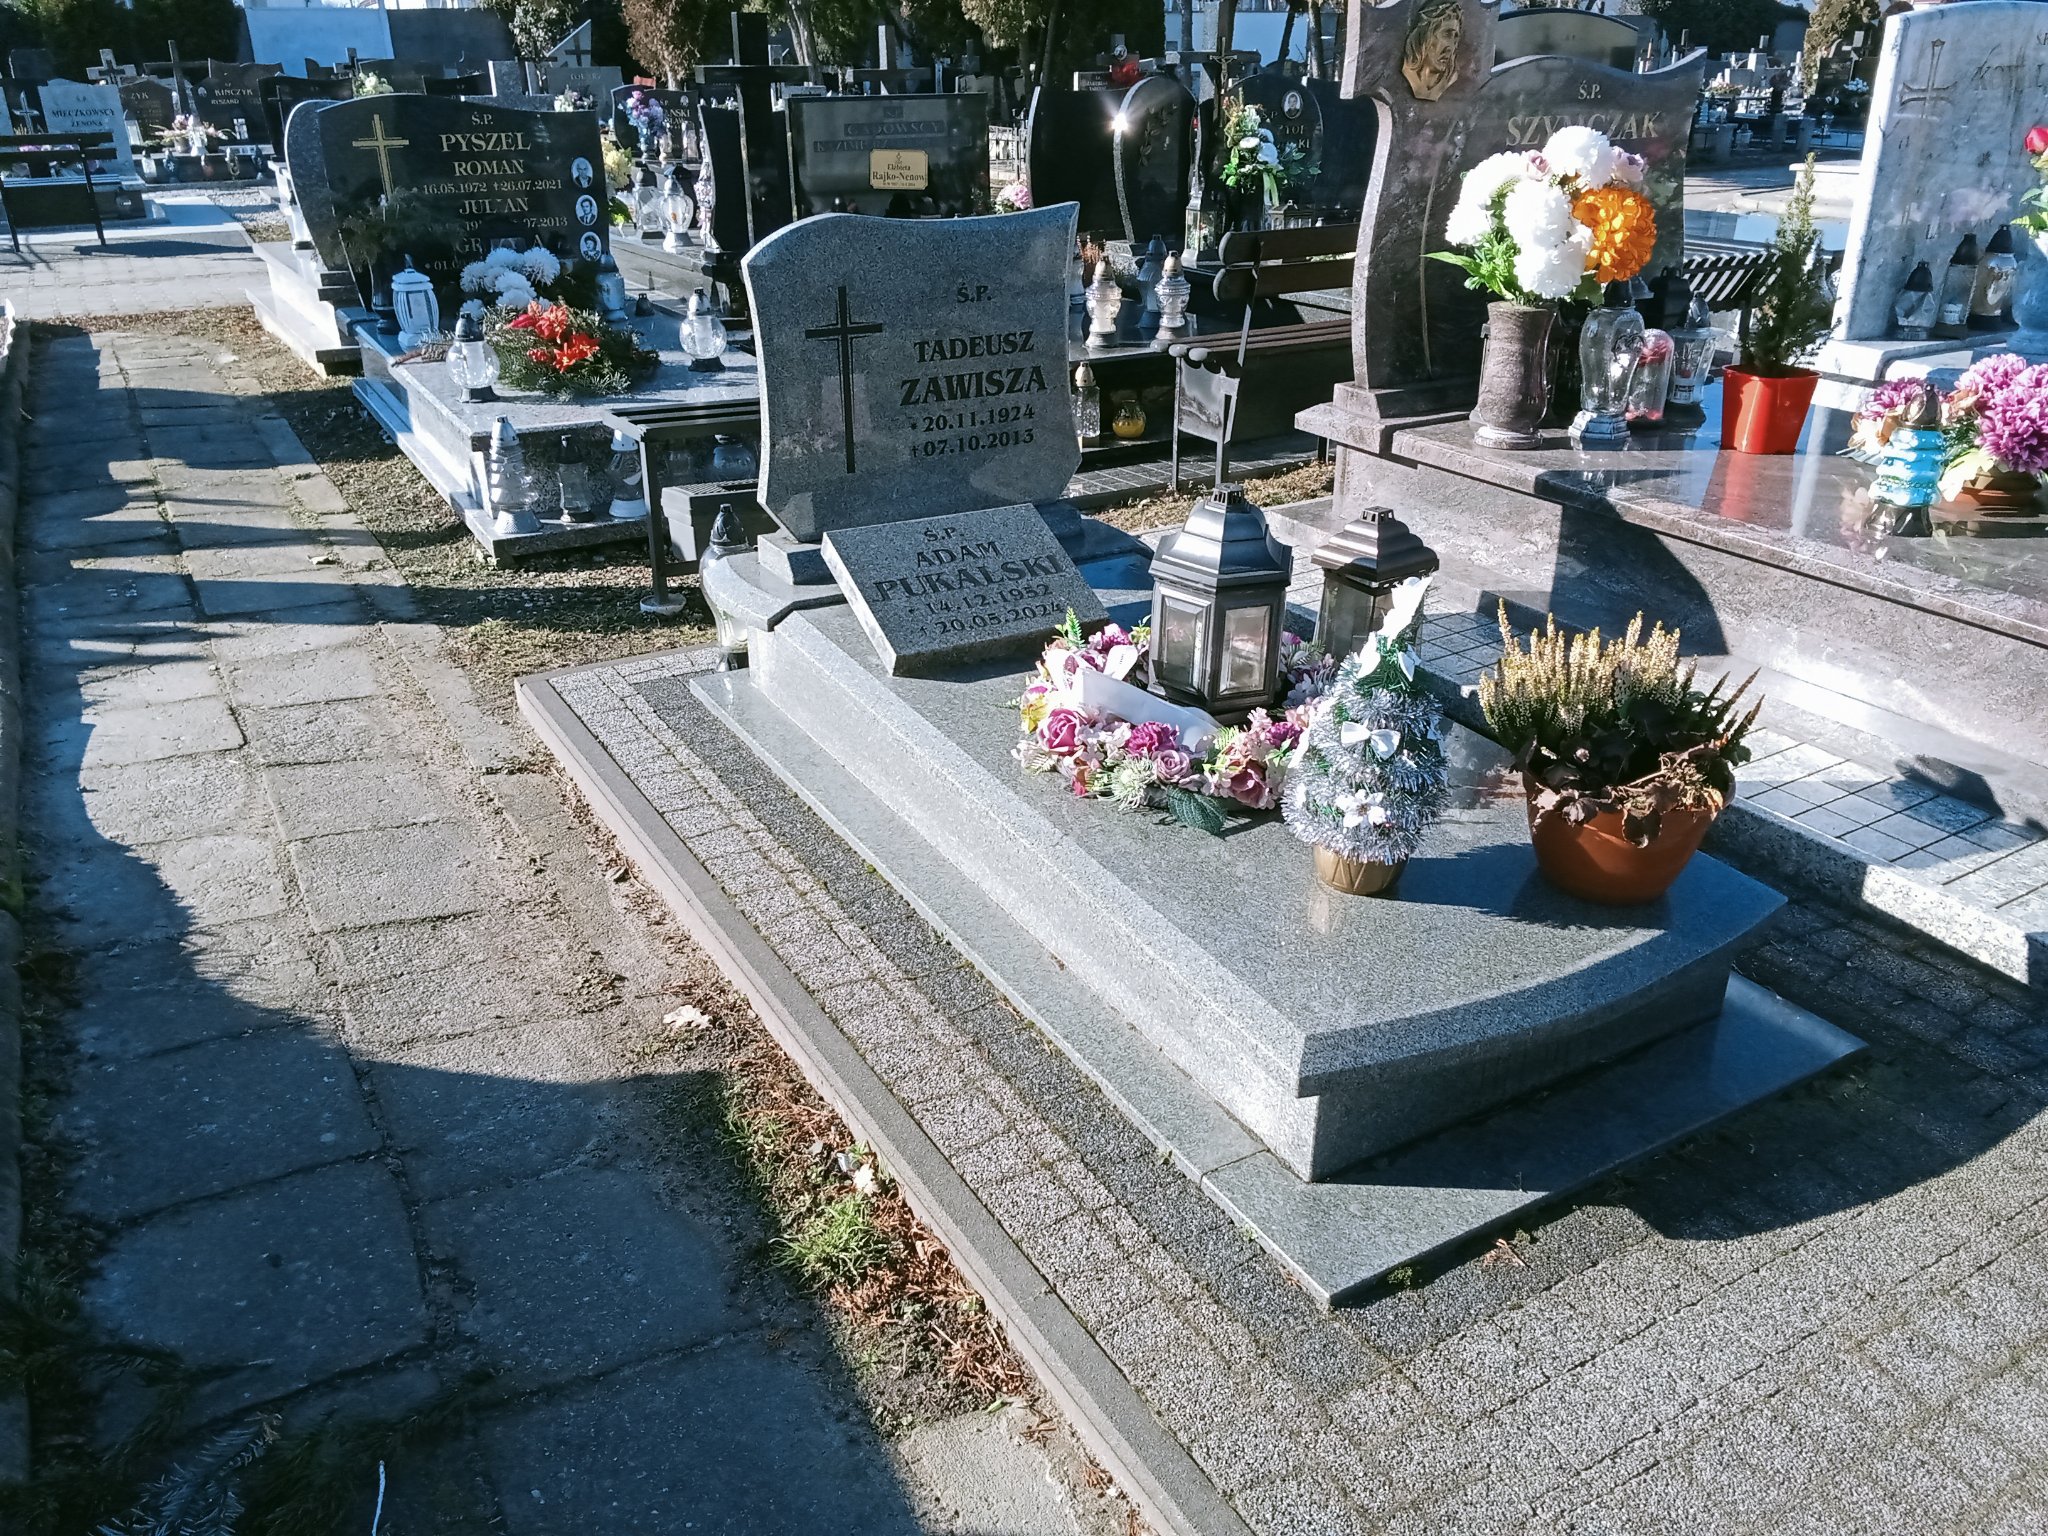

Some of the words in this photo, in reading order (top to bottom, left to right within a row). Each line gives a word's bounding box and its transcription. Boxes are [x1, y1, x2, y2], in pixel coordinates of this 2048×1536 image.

[1578, 80, 1602, 100] Ś.P.
[471, 112, 494, 125] Ś.P.
[439, 132, 532, 152] PYSZEL
[453, 159, 525, 176] ROMAN
[459, 197, 530, 215] JULAN
[956, 281, 993, 303] Ś.P.
[913, 330, 1035, 363] TADEUSZ
[899, 365, 1048, 406] ZAWISZA
[917, 541, 1001, 568] ADAM
[872, 553, 1065, 601] PUKALSKI
